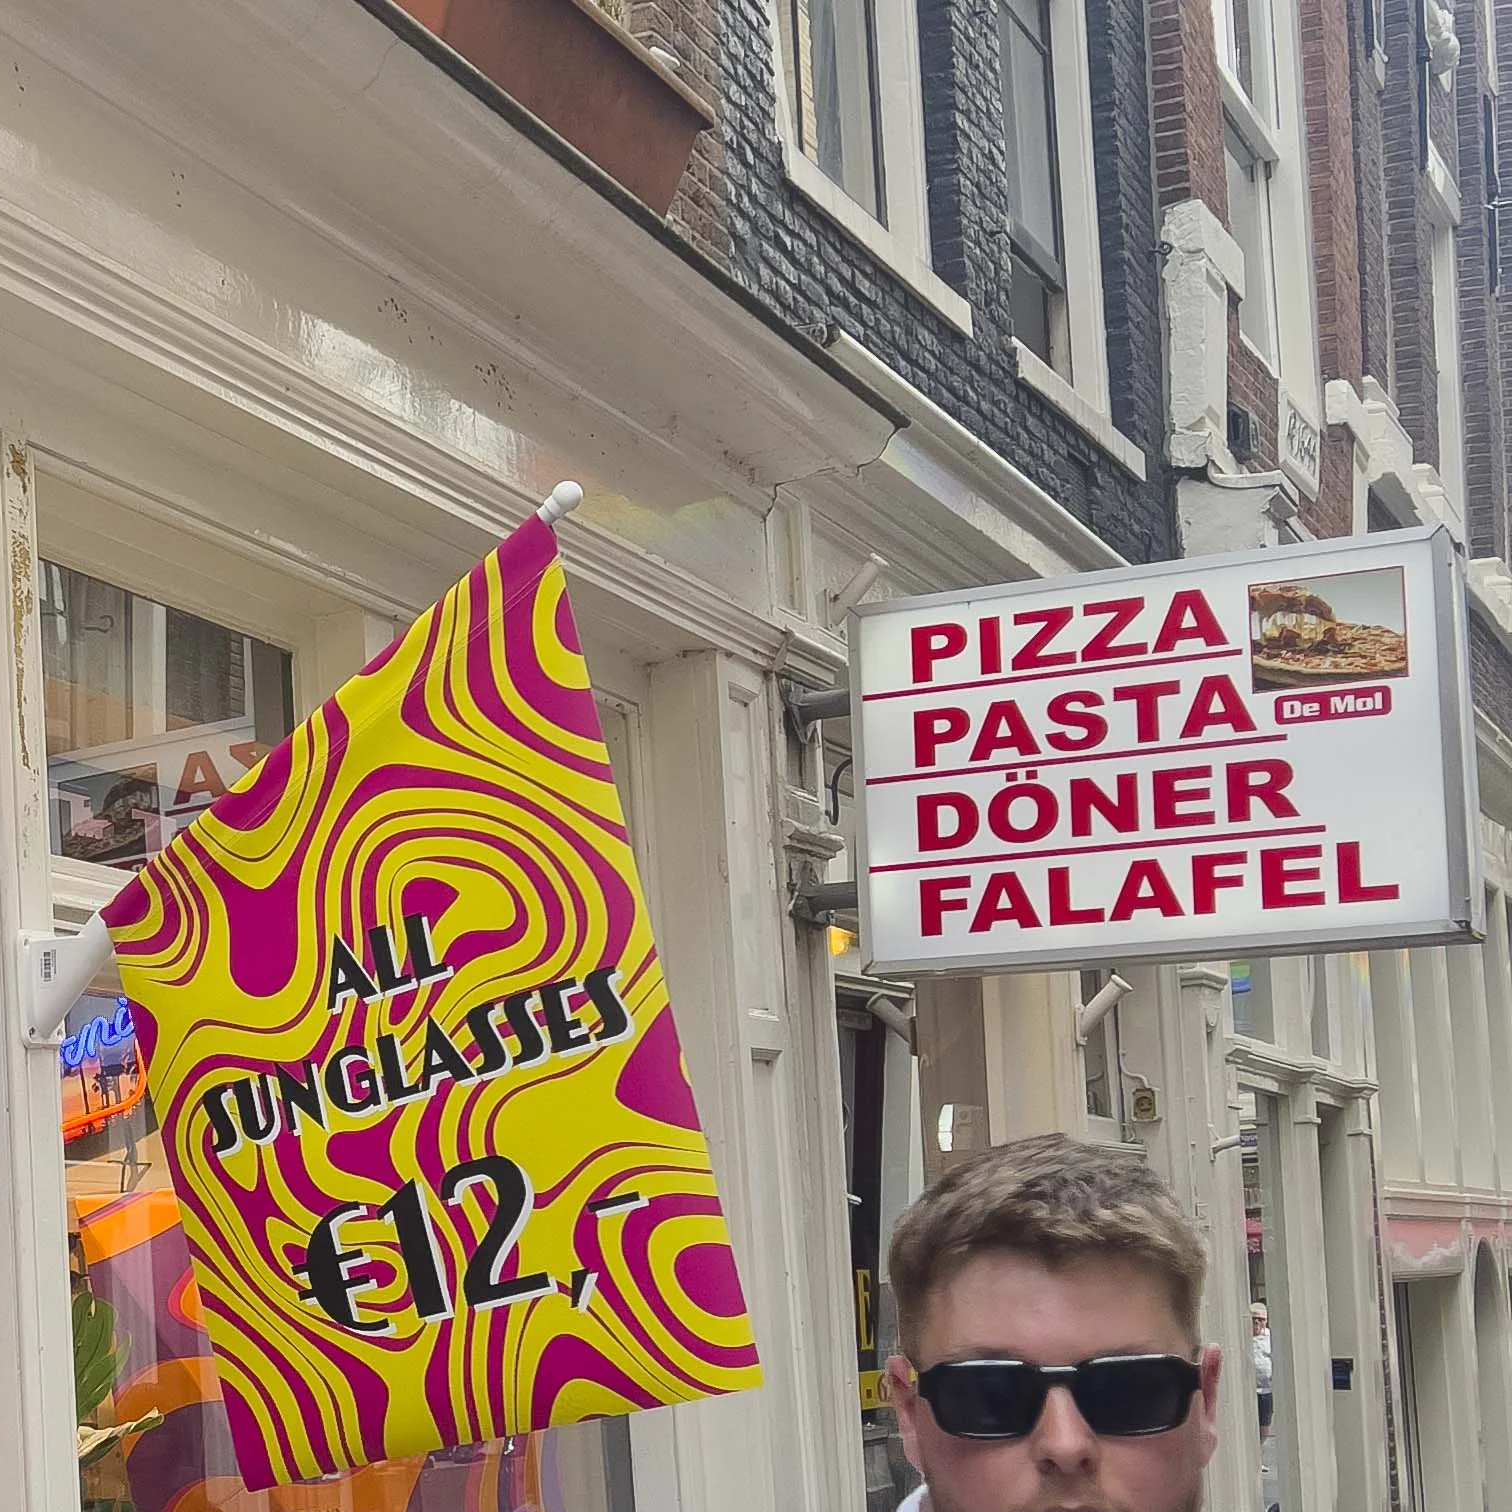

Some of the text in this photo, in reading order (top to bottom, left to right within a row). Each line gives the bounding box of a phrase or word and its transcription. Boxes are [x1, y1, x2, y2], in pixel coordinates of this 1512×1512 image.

[910, 589, 1229, 684] PIZZA
[913, 674, 1258, 768] PASTA
[1282, 691, 1383, 718] De Mol
[916, 758, 1302, 852] DÖNER
[919, 841, 1400, 937] FALAFEL
[327, 913, 454, 1016] ALL
[202, 966, 636, 1159] SUNGLASSES
